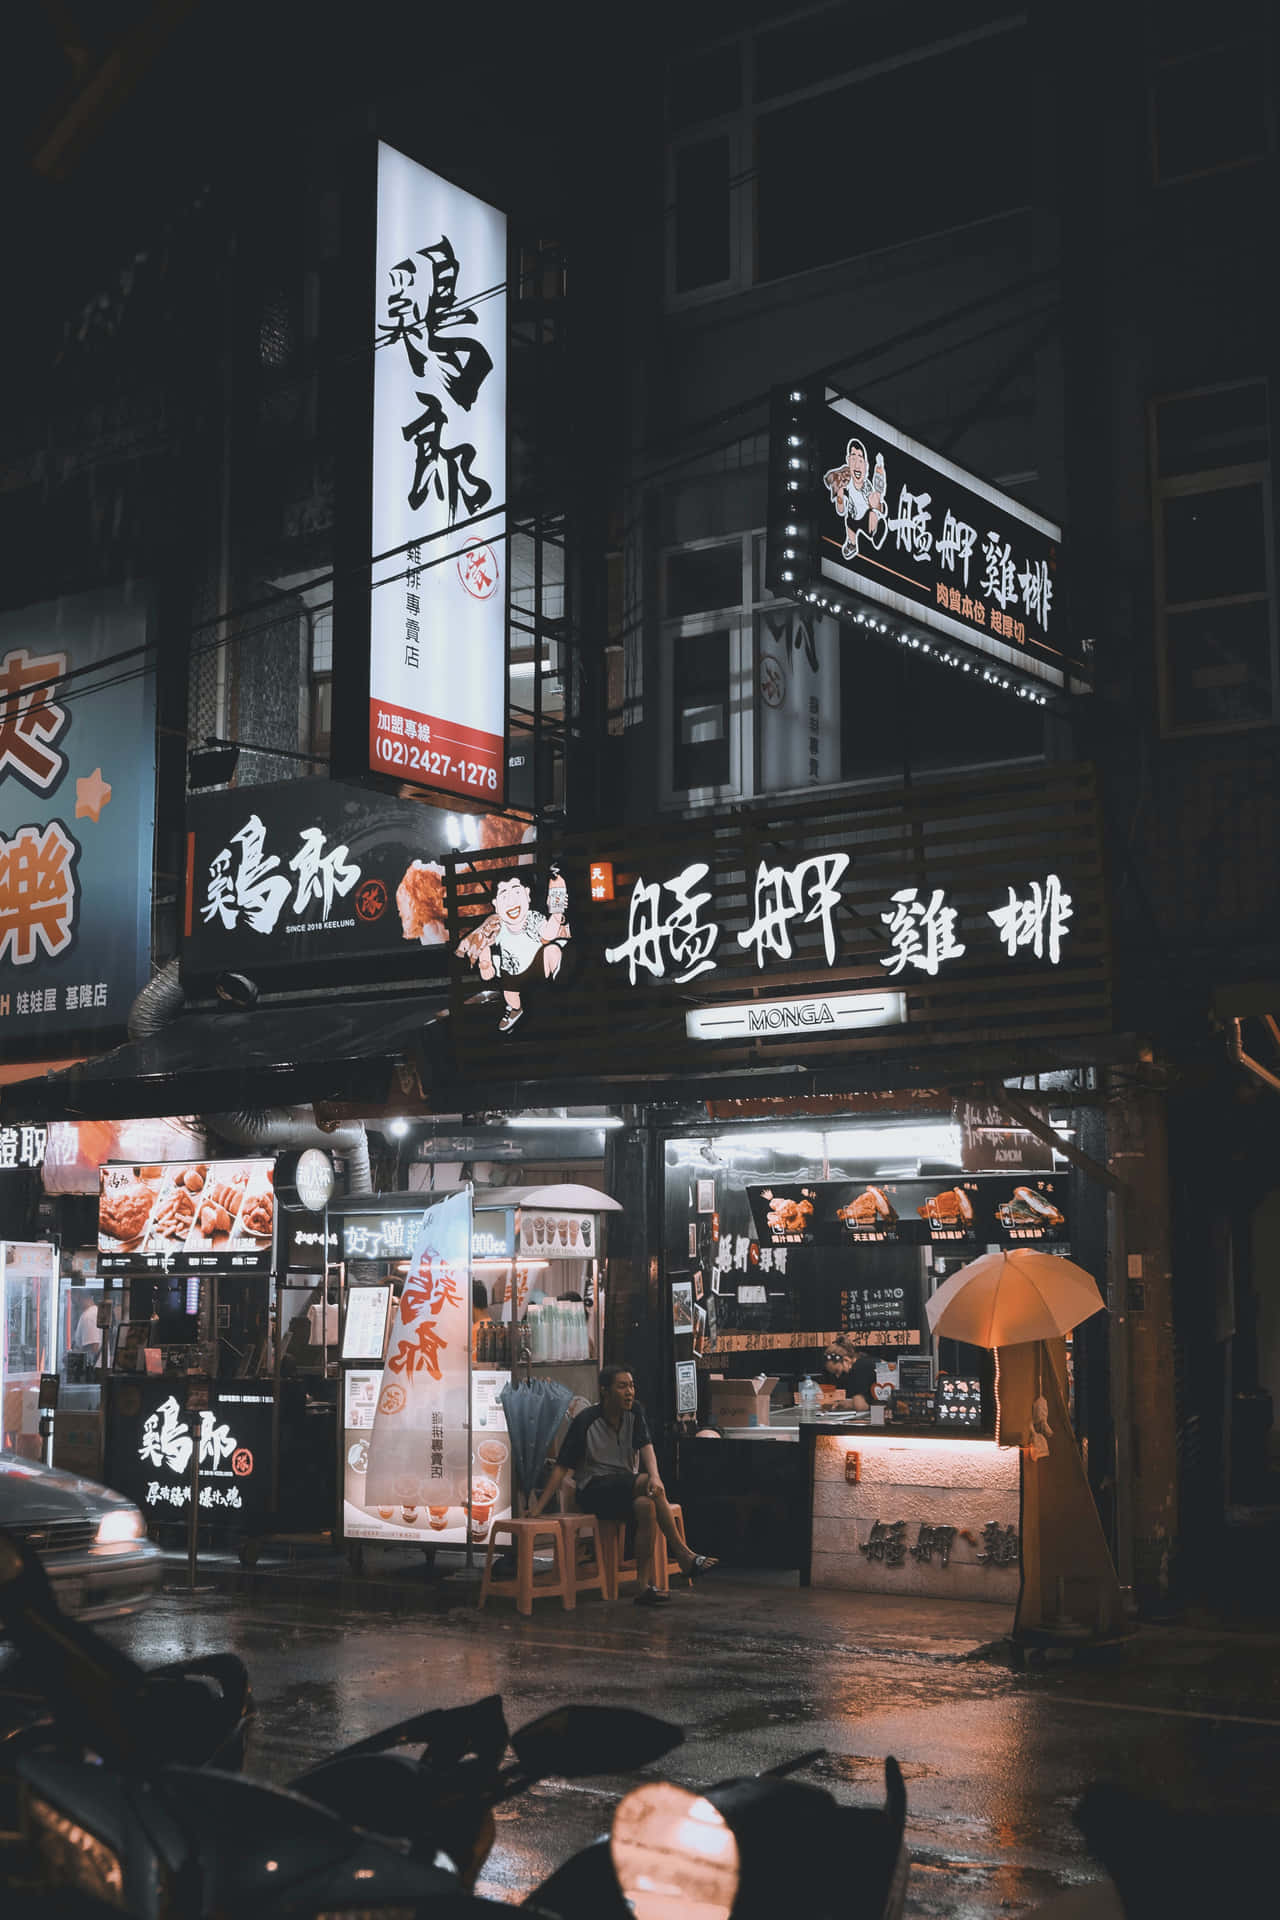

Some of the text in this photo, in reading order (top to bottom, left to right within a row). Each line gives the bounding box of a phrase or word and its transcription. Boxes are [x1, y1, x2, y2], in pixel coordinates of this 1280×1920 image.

[377, 710, 430, 743] 加盟專線
[376, 736, 497, 790] (02)2427-1278
[286, 924, 305, 933] SINCE
[323, 919, 355, 929] KEELUNG
[16, 988, 57, 1014] 娃娃屋
[65, 982, 108, 1010] 基隆店
[748, 1003, 834, 1031] MONGA
